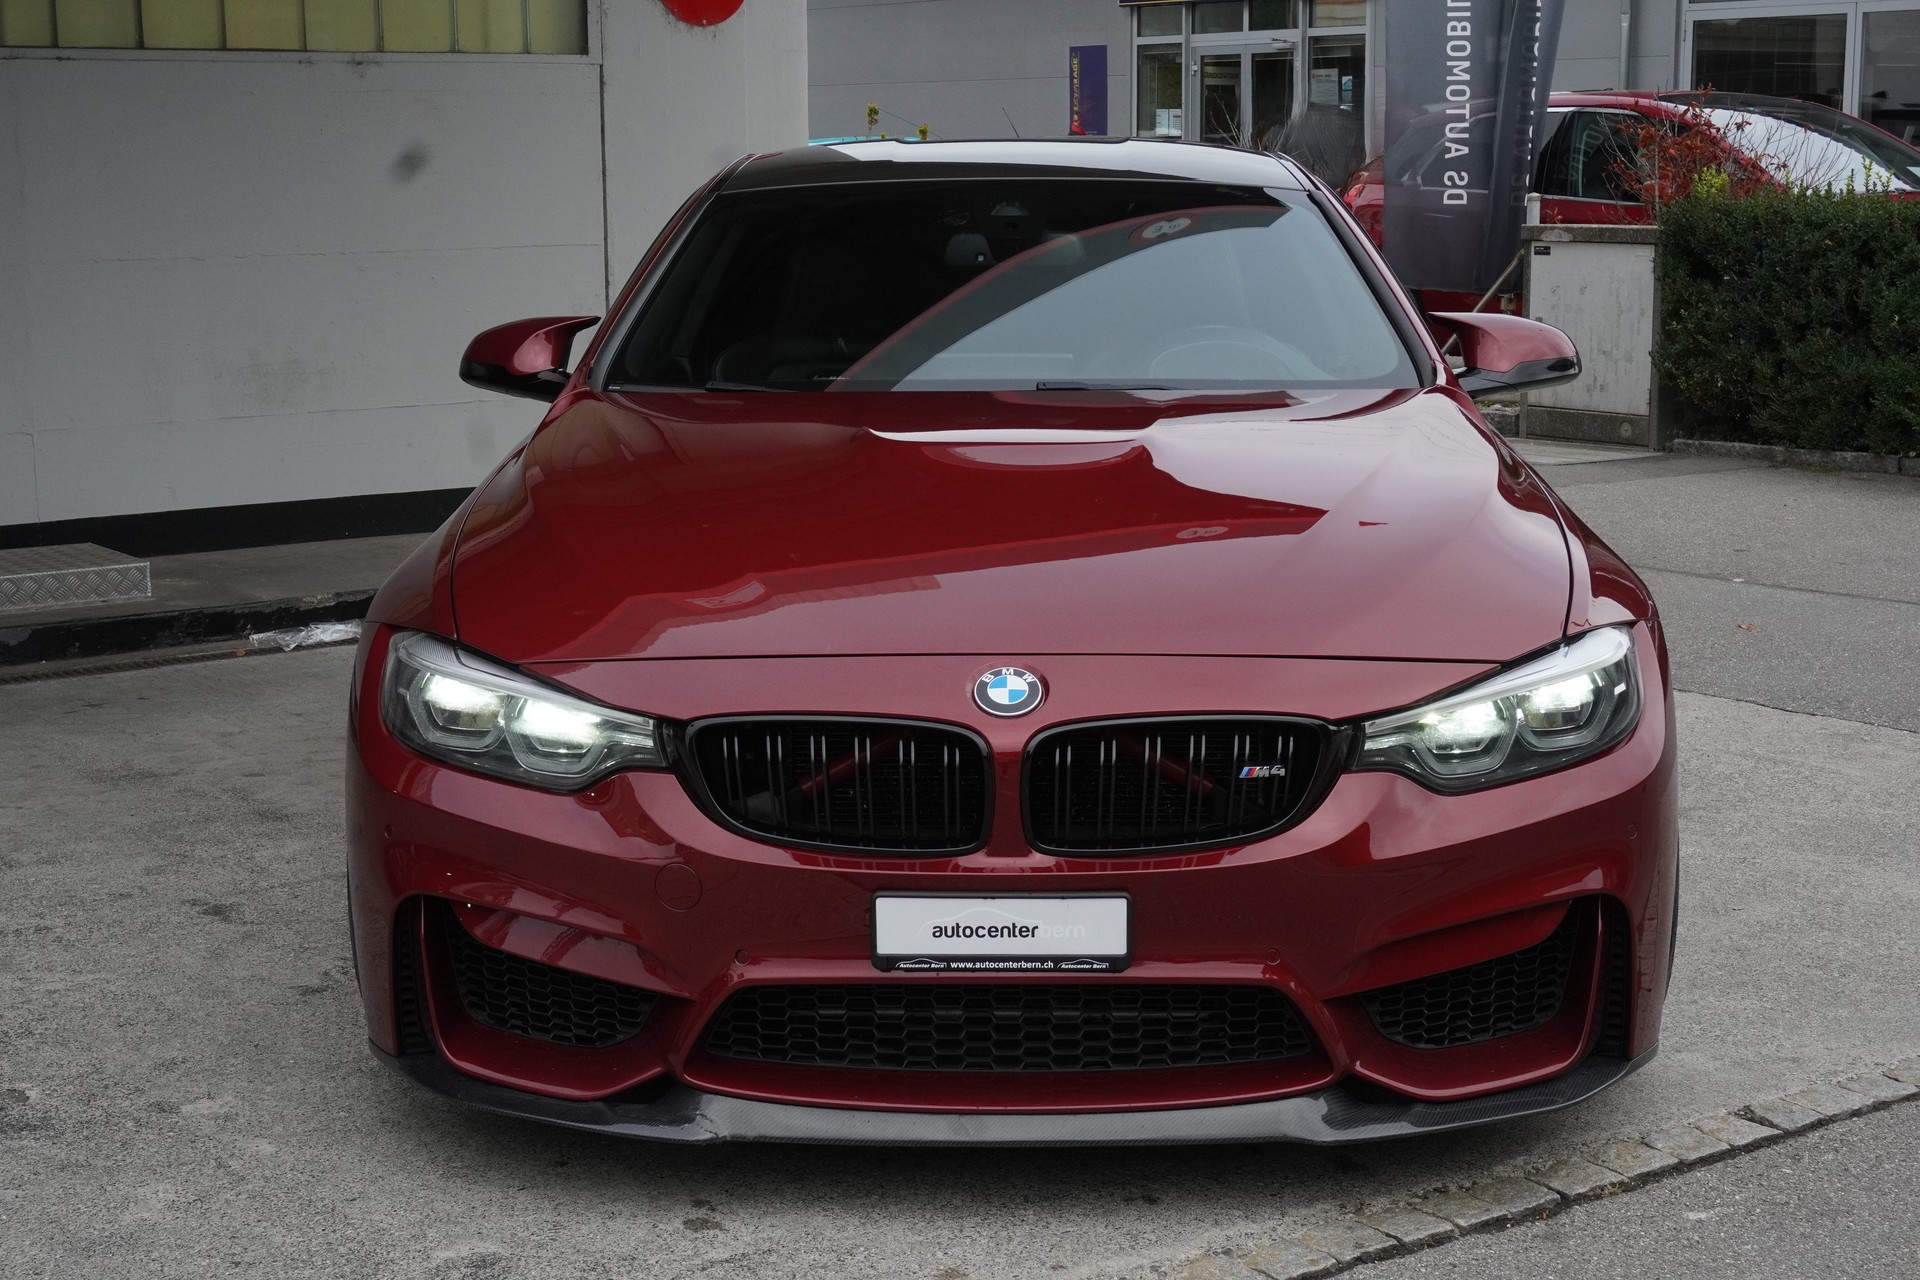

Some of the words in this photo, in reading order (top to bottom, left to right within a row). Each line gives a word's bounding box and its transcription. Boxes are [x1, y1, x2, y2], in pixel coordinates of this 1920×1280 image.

[981, 668, 1036, 683] BMW
[1253, 765, 1285, 777] M4
[950, 960, 1054, 969] www.autocenterbern.ch
